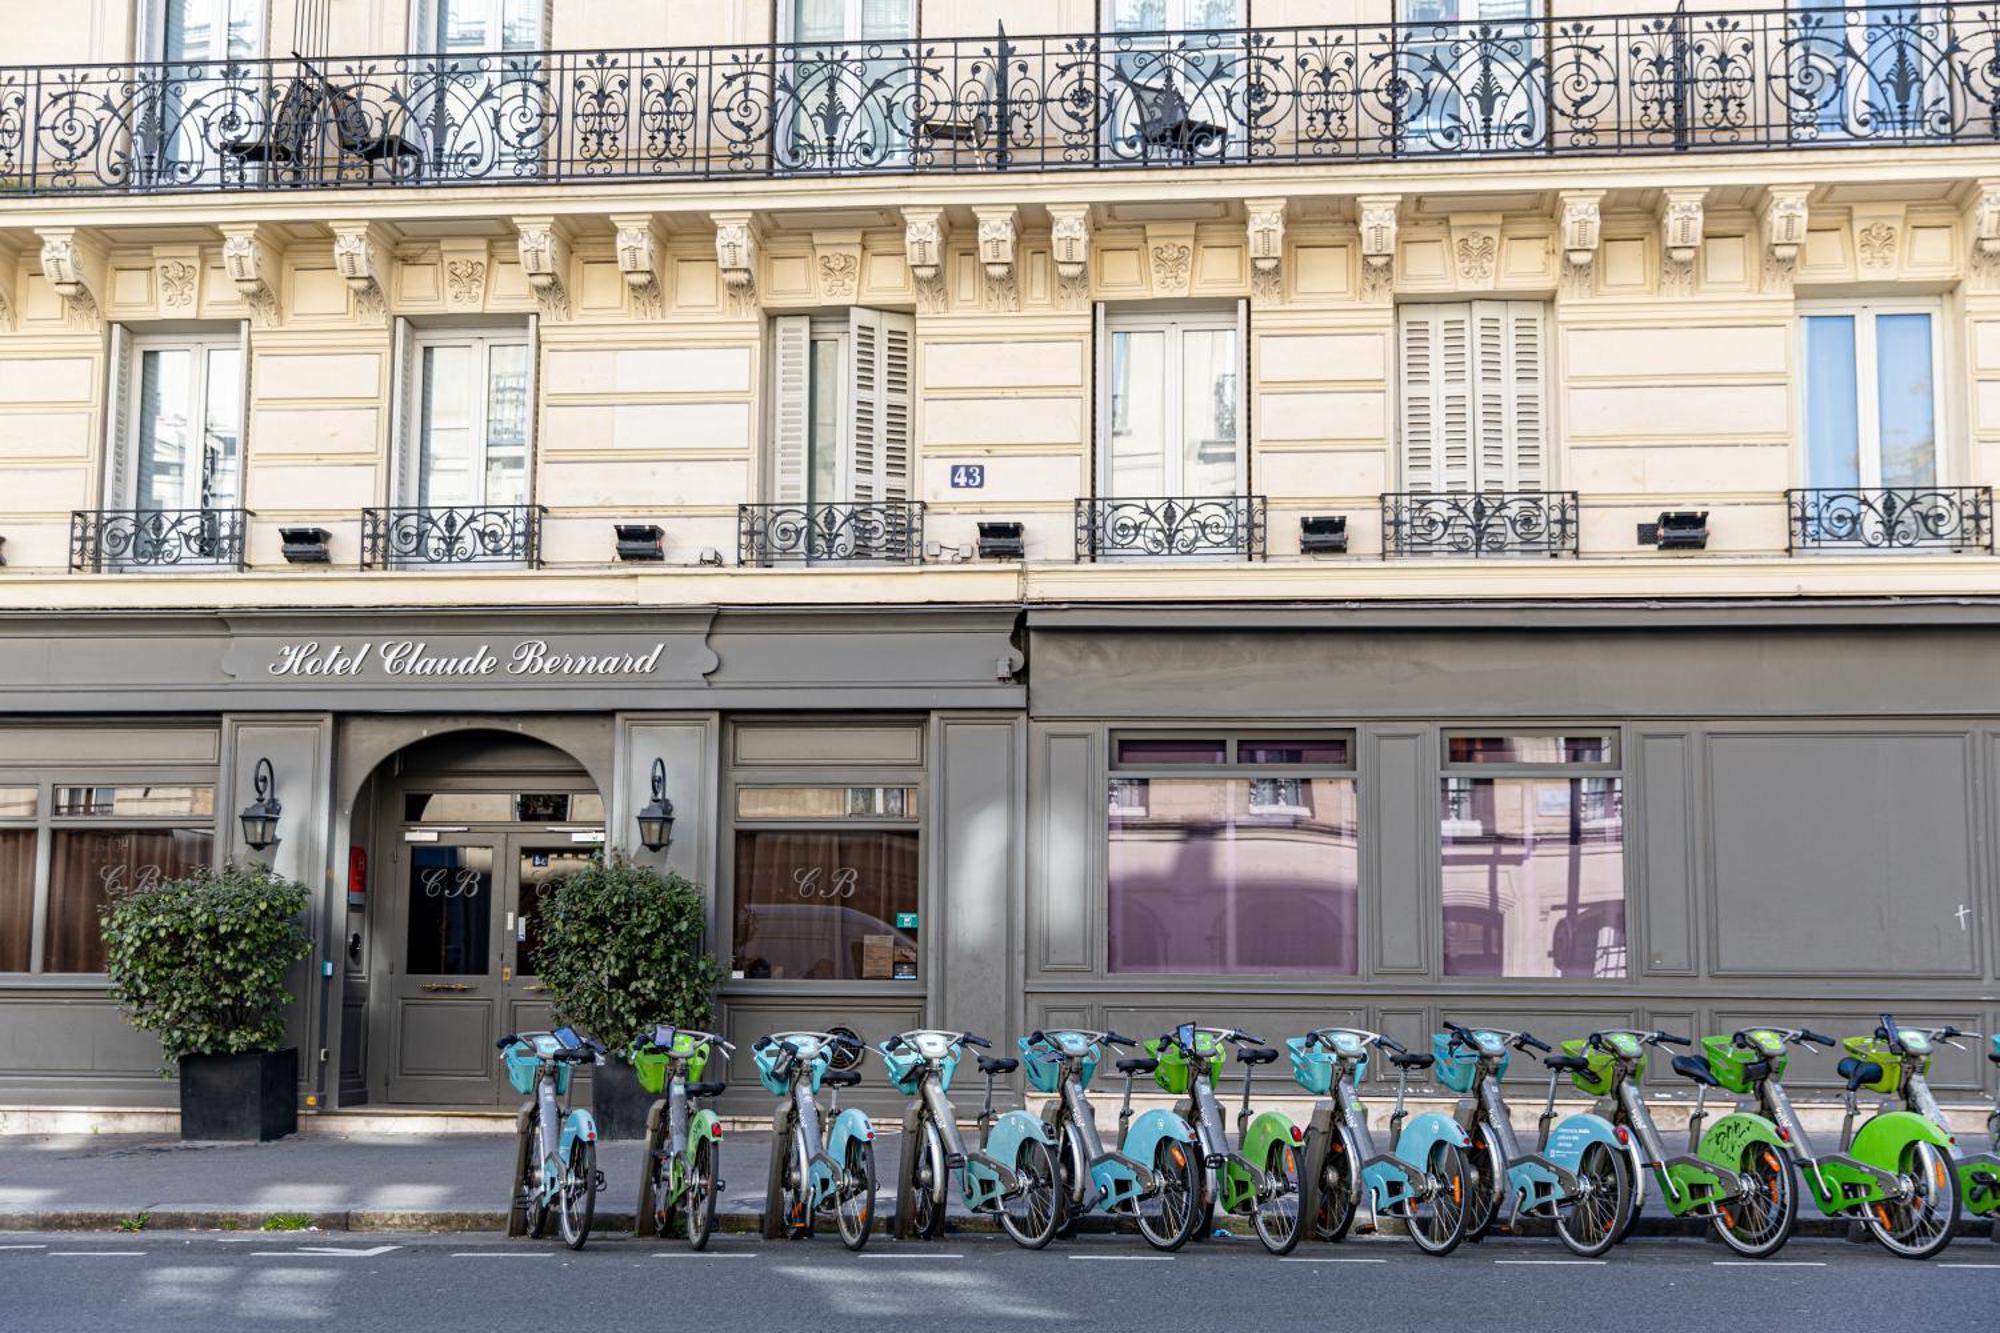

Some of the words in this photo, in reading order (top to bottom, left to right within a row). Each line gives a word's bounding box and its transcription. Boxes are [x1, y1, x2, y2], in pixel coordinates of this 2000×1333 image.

[954, 466, 981, 487] 43
[268, 641, 372, 676] Hotel
[379, 640, 498, 676] Claude
[507, 639, 666, 675] Bernard
